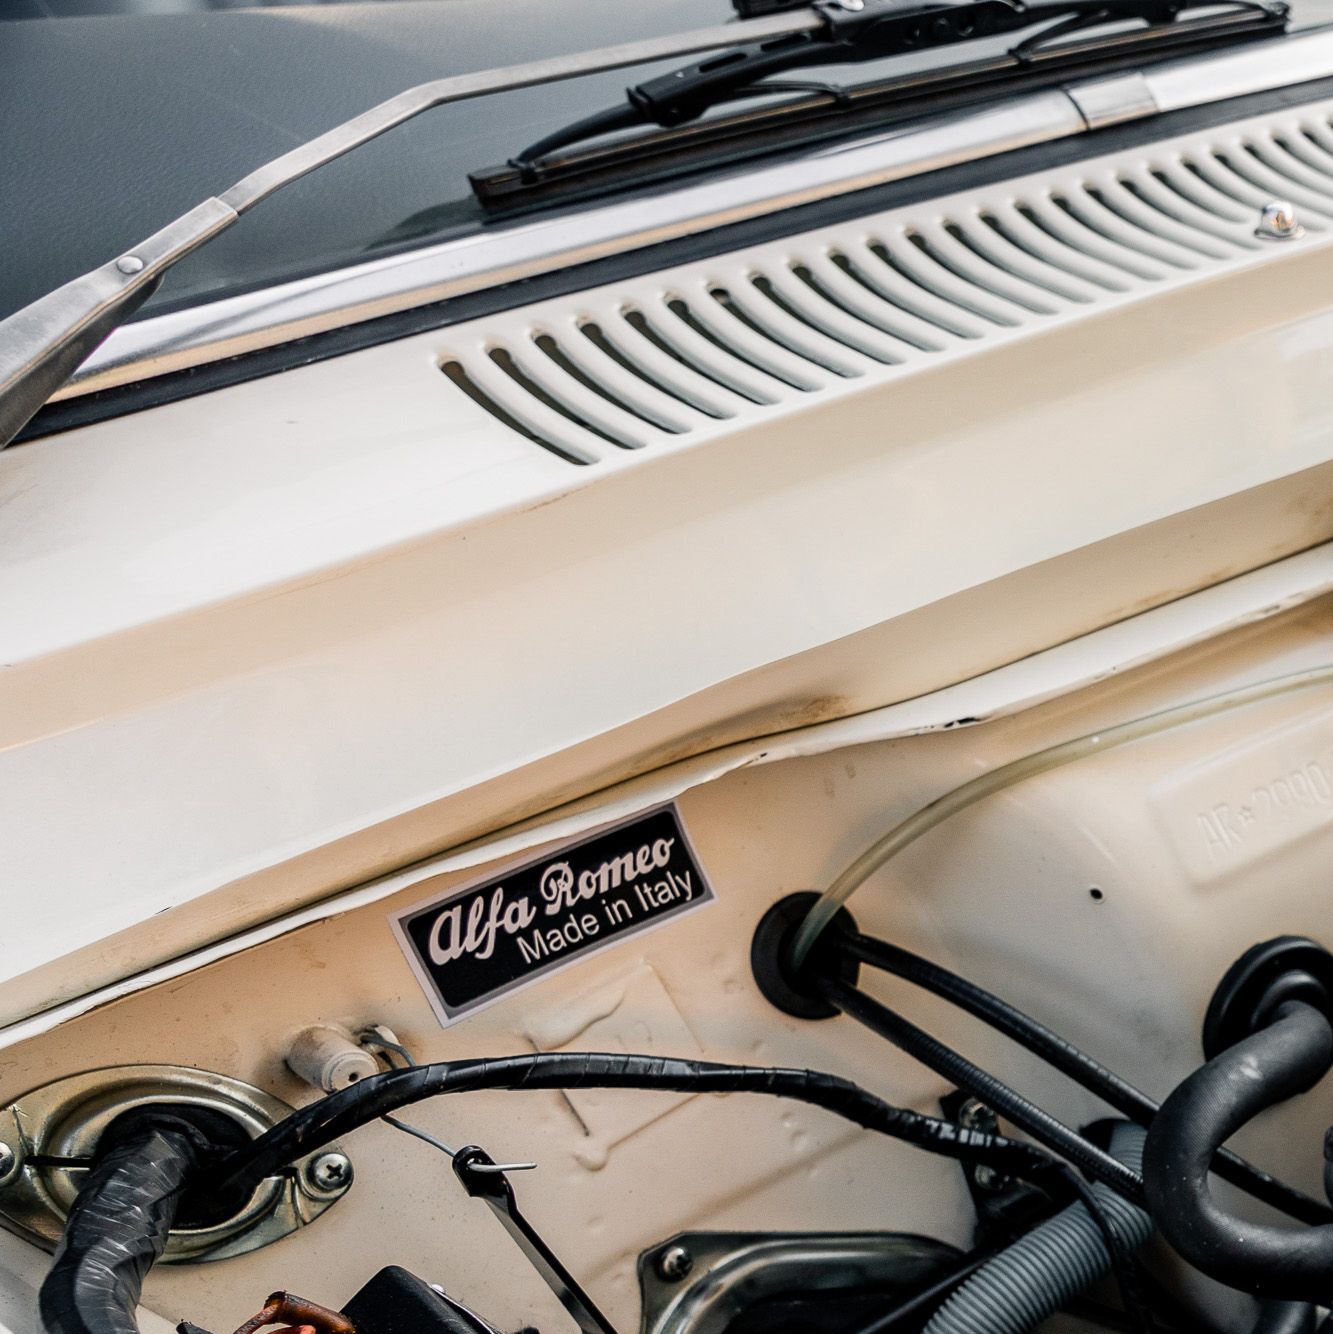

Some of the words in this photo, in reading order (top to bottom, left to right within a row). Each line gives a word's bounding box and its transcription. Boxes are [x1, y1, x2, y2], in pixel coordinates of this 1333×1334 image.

[428, 887, 537, 966] Alfa
[540, 837, 675, 916] Romeo
[516, 912, 600, 965] Made
[601, 895, 633, 927] in
[634, 871, 695, 914] Italy
